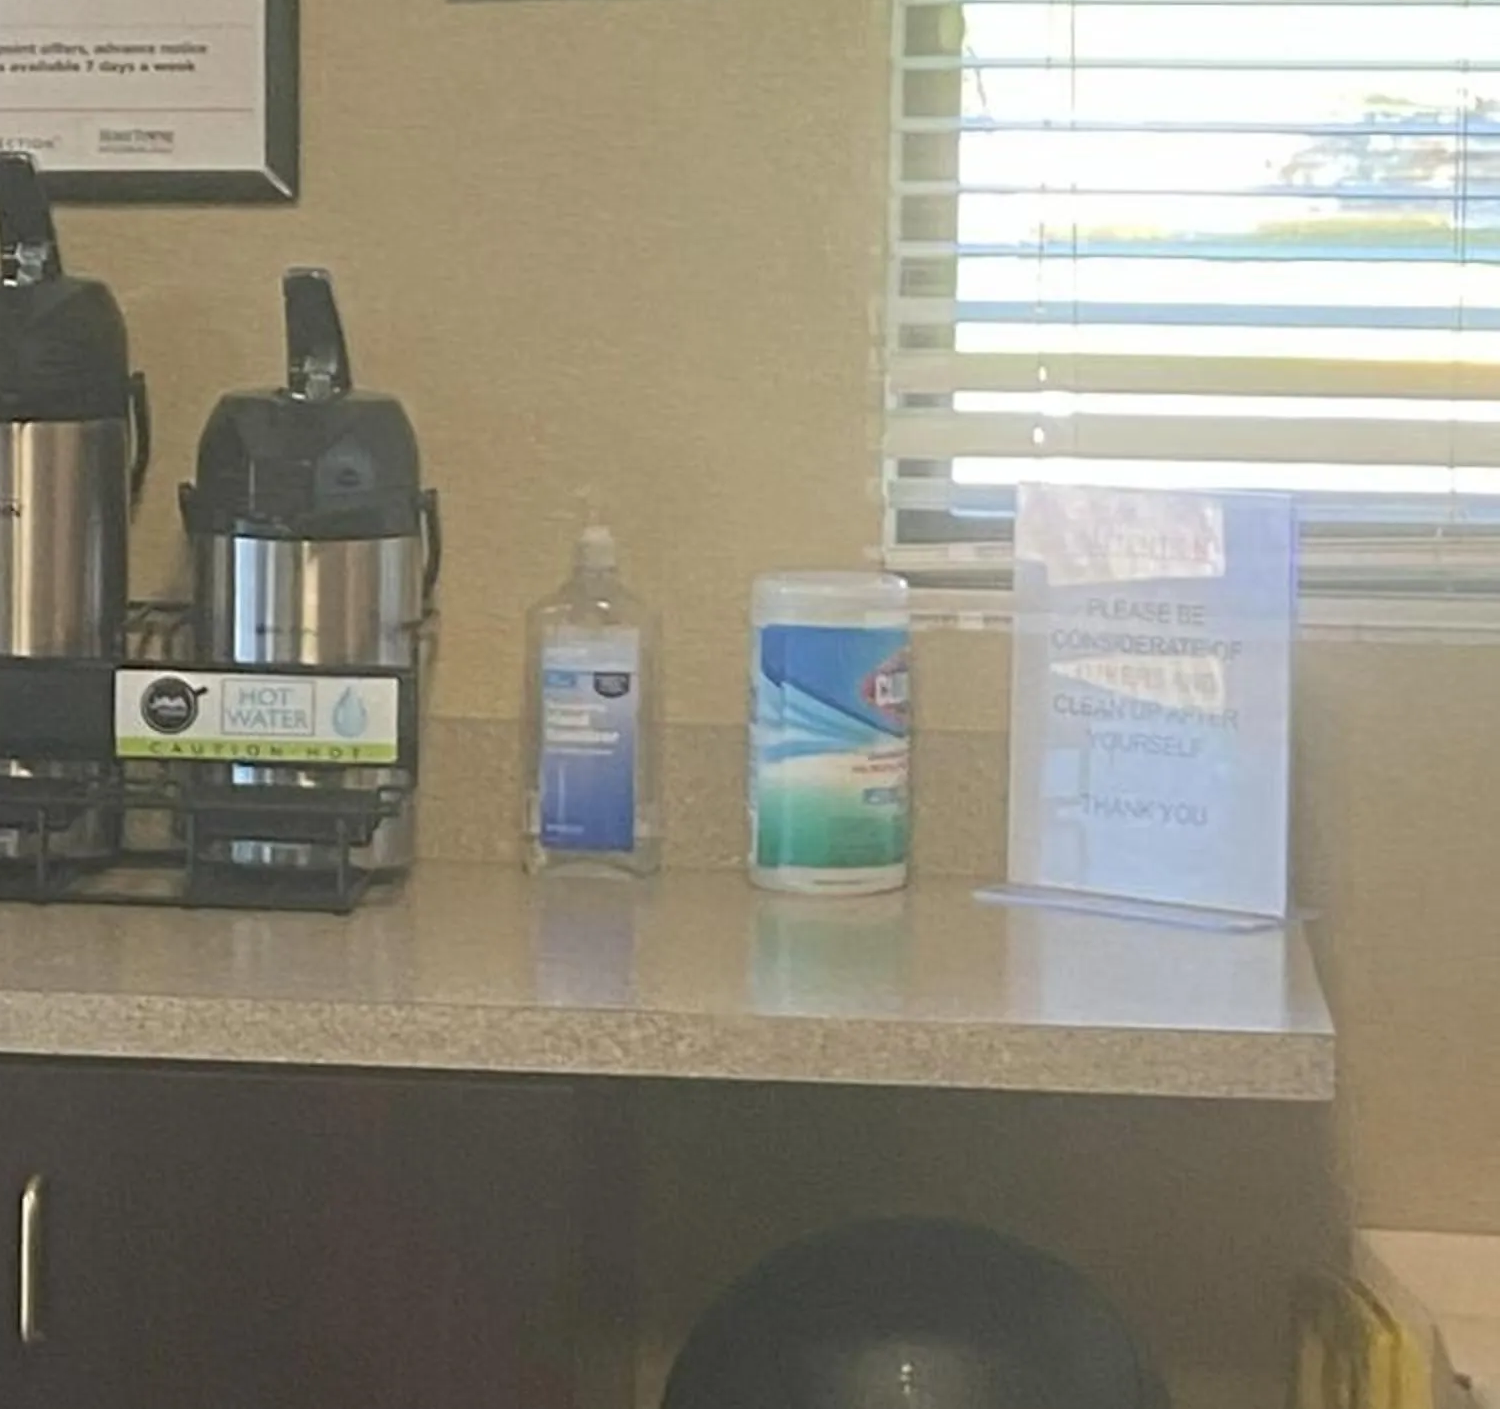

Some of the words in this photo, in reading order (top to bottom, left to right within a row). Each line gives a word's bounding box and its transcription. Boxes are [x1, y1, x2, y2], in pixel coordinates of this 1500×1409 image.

[1086, 597, 1172, 625] PLEASE
[1178, 604, 1206, 627] BE
[1052, 627, 1206, 657] CONSIDERATE
[1210, 638, 1243, 663] OF
[238, 687, 290, 706] HOT
[1052, 692, 1129, 722] CLEAN
[225, 709, 308, 729] WATER
[149, 742, 283, 758] CAUTION
[306, 746, 361, 761] HOT
[1086, 729, 1204, 759] YOURSELF
[1081, 794, 1155, 822] THANK
[1160, 801, 1209, 827] YOU
